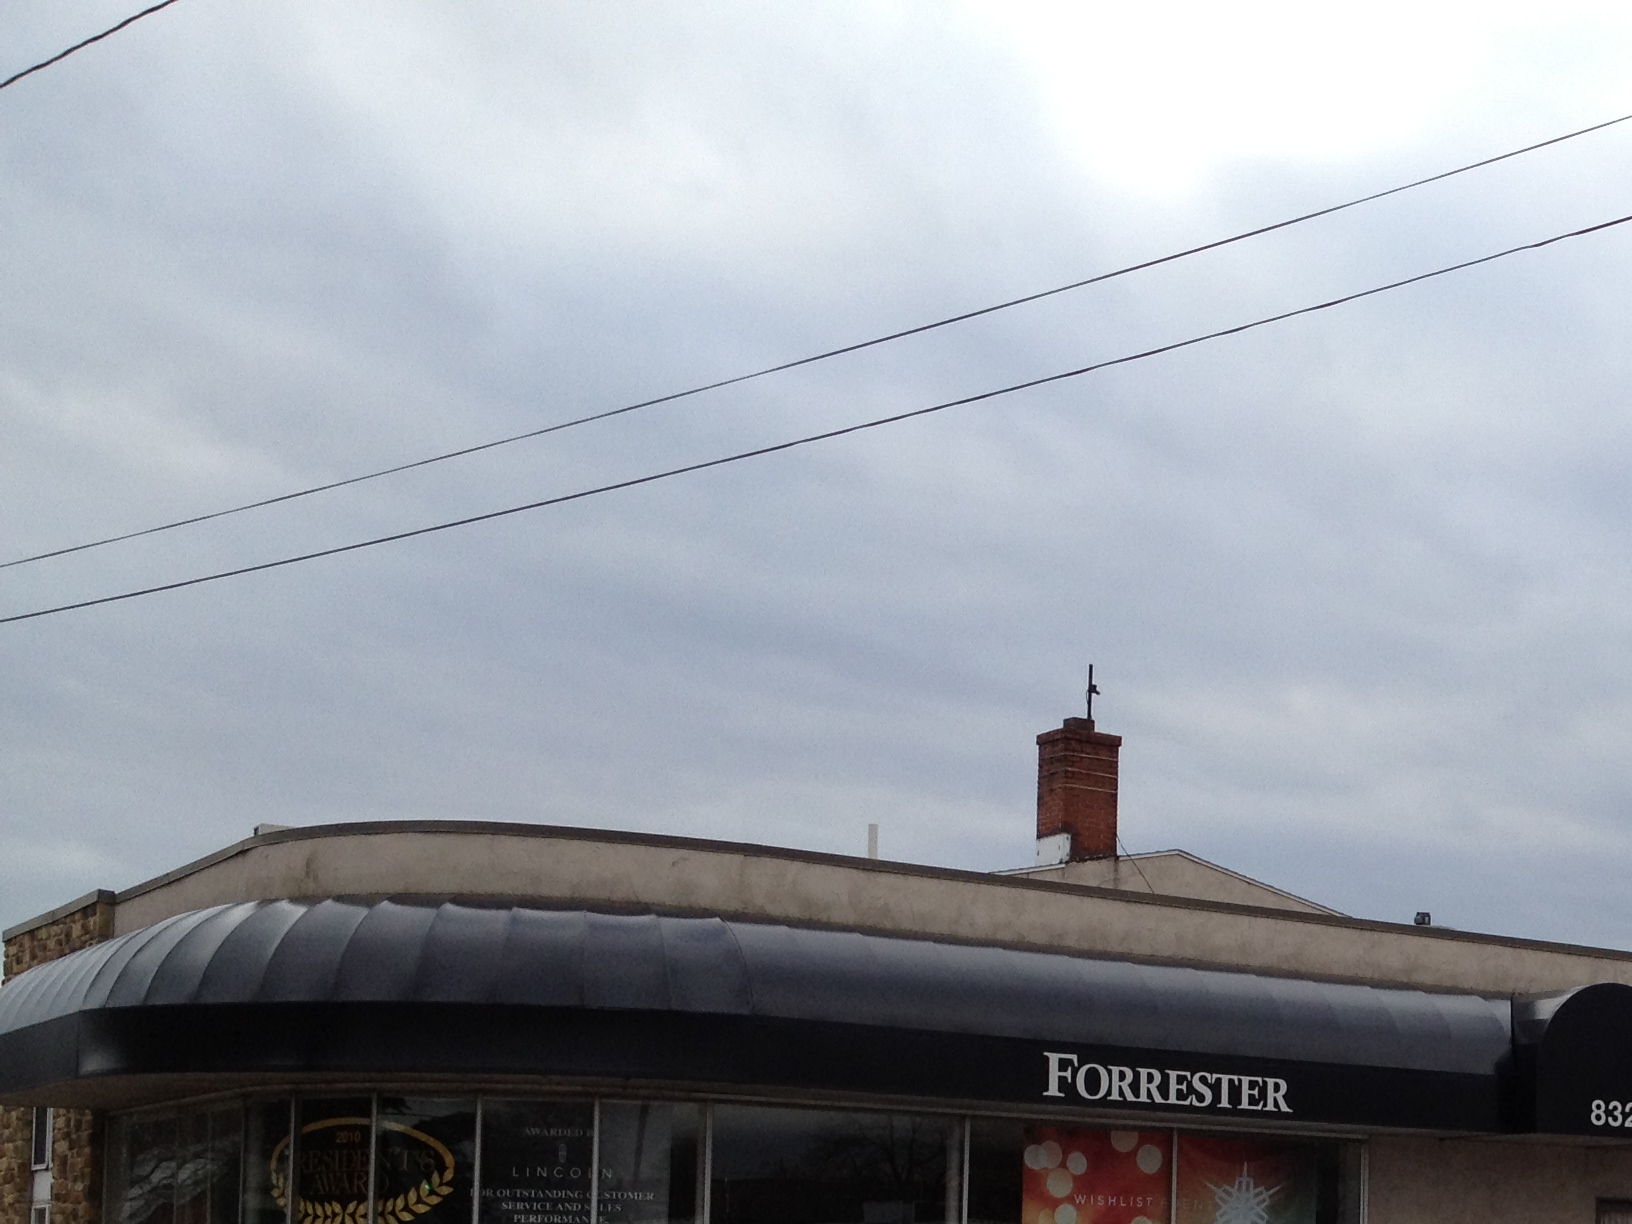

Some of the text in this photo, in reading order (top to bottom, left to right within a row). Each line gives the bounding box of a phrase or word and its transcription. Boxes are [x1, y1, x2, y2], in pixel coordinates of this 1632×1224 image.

[1043, 1052, 1292, 1112] FORRESTER
[335, 1130, 361, 1143] 2010
[524, 1127, 583, 1137] AWARDED
[496, 1188, 583, 1200] OUTSTANDING
[501, 1201, 622, 1212] SERVICE AND SLES
[1074, 1194, 1153, 1207] WISHLIST
